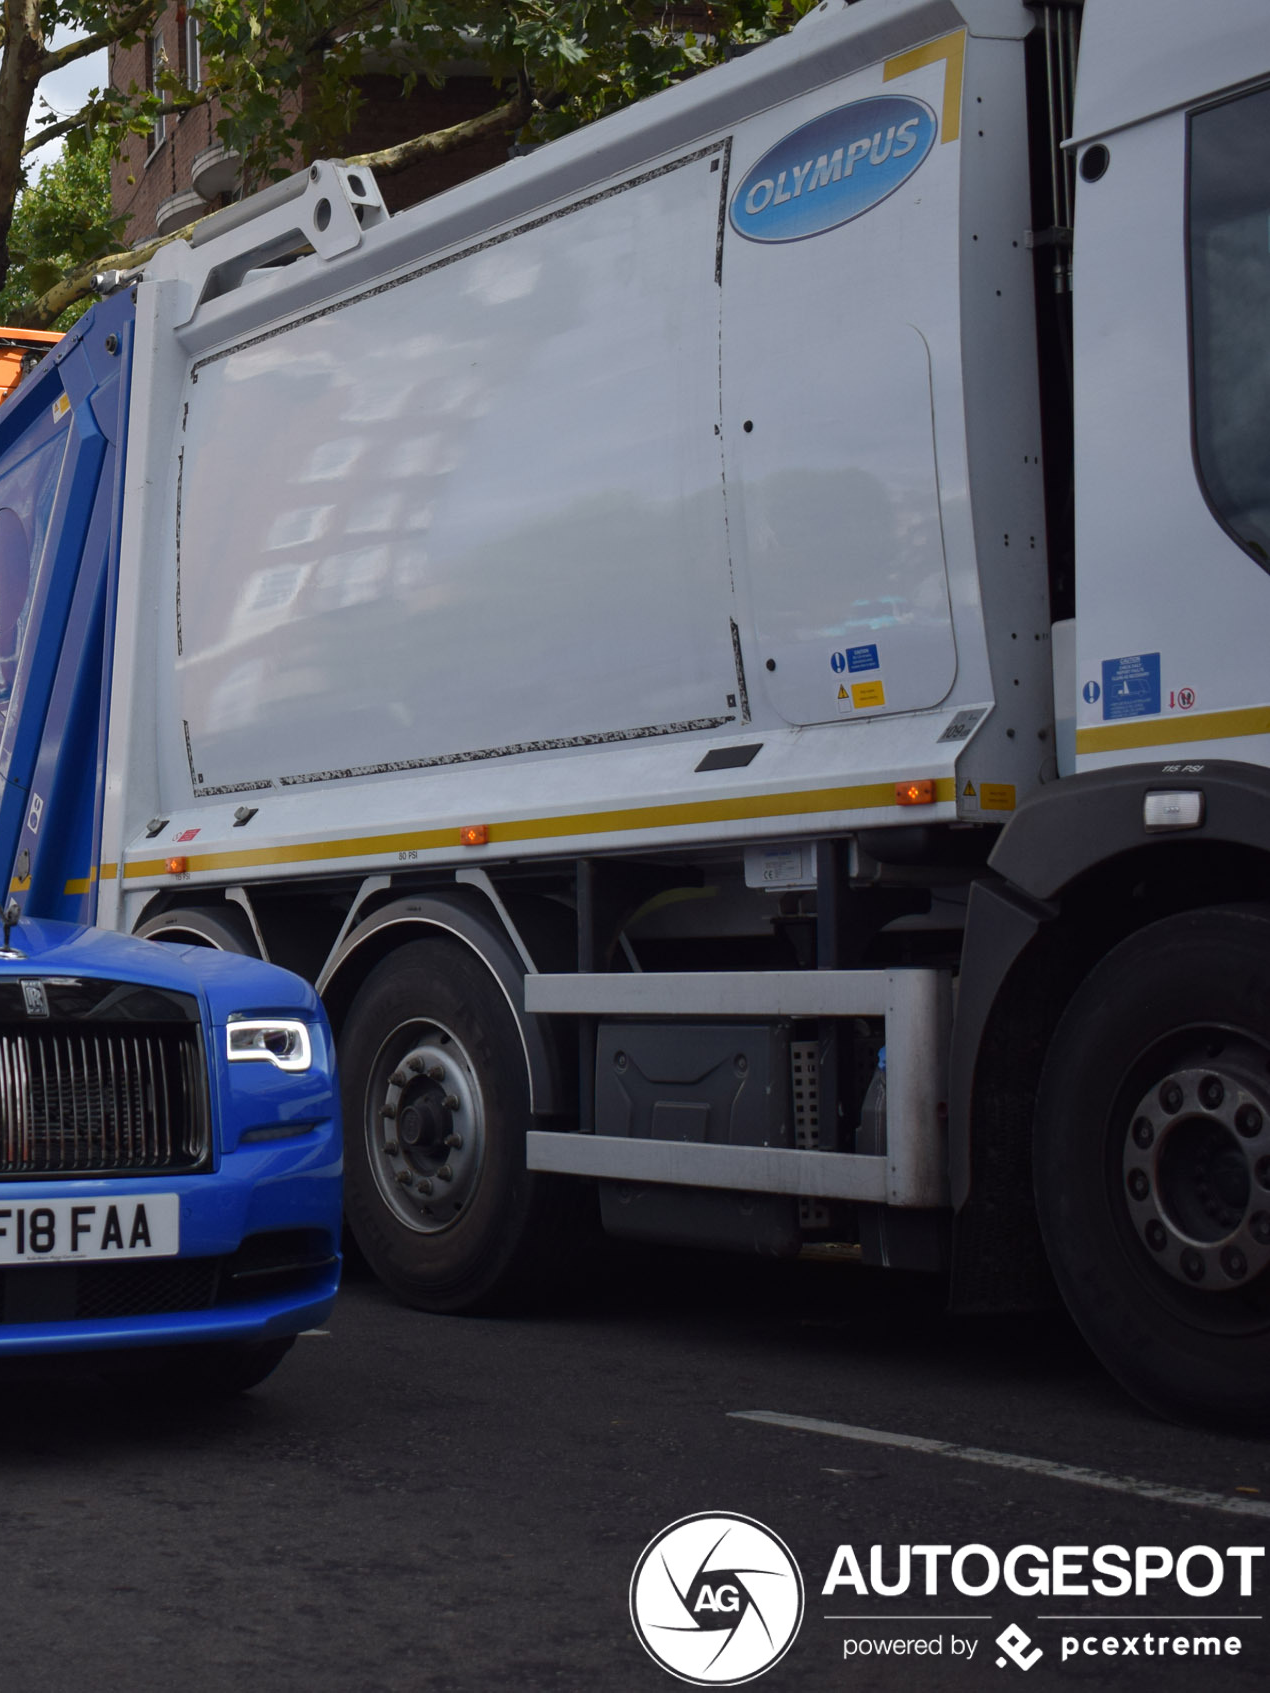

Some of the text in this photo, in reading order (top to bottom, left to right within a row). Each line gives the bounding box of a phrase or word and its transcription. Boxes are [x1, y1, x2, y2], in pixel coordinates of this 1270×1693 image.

[745, 117, 919, 215] OLYMPUS
[398, 851, 418, 860] 80 PSI
[71, 1203, 152, 1252] FAA
